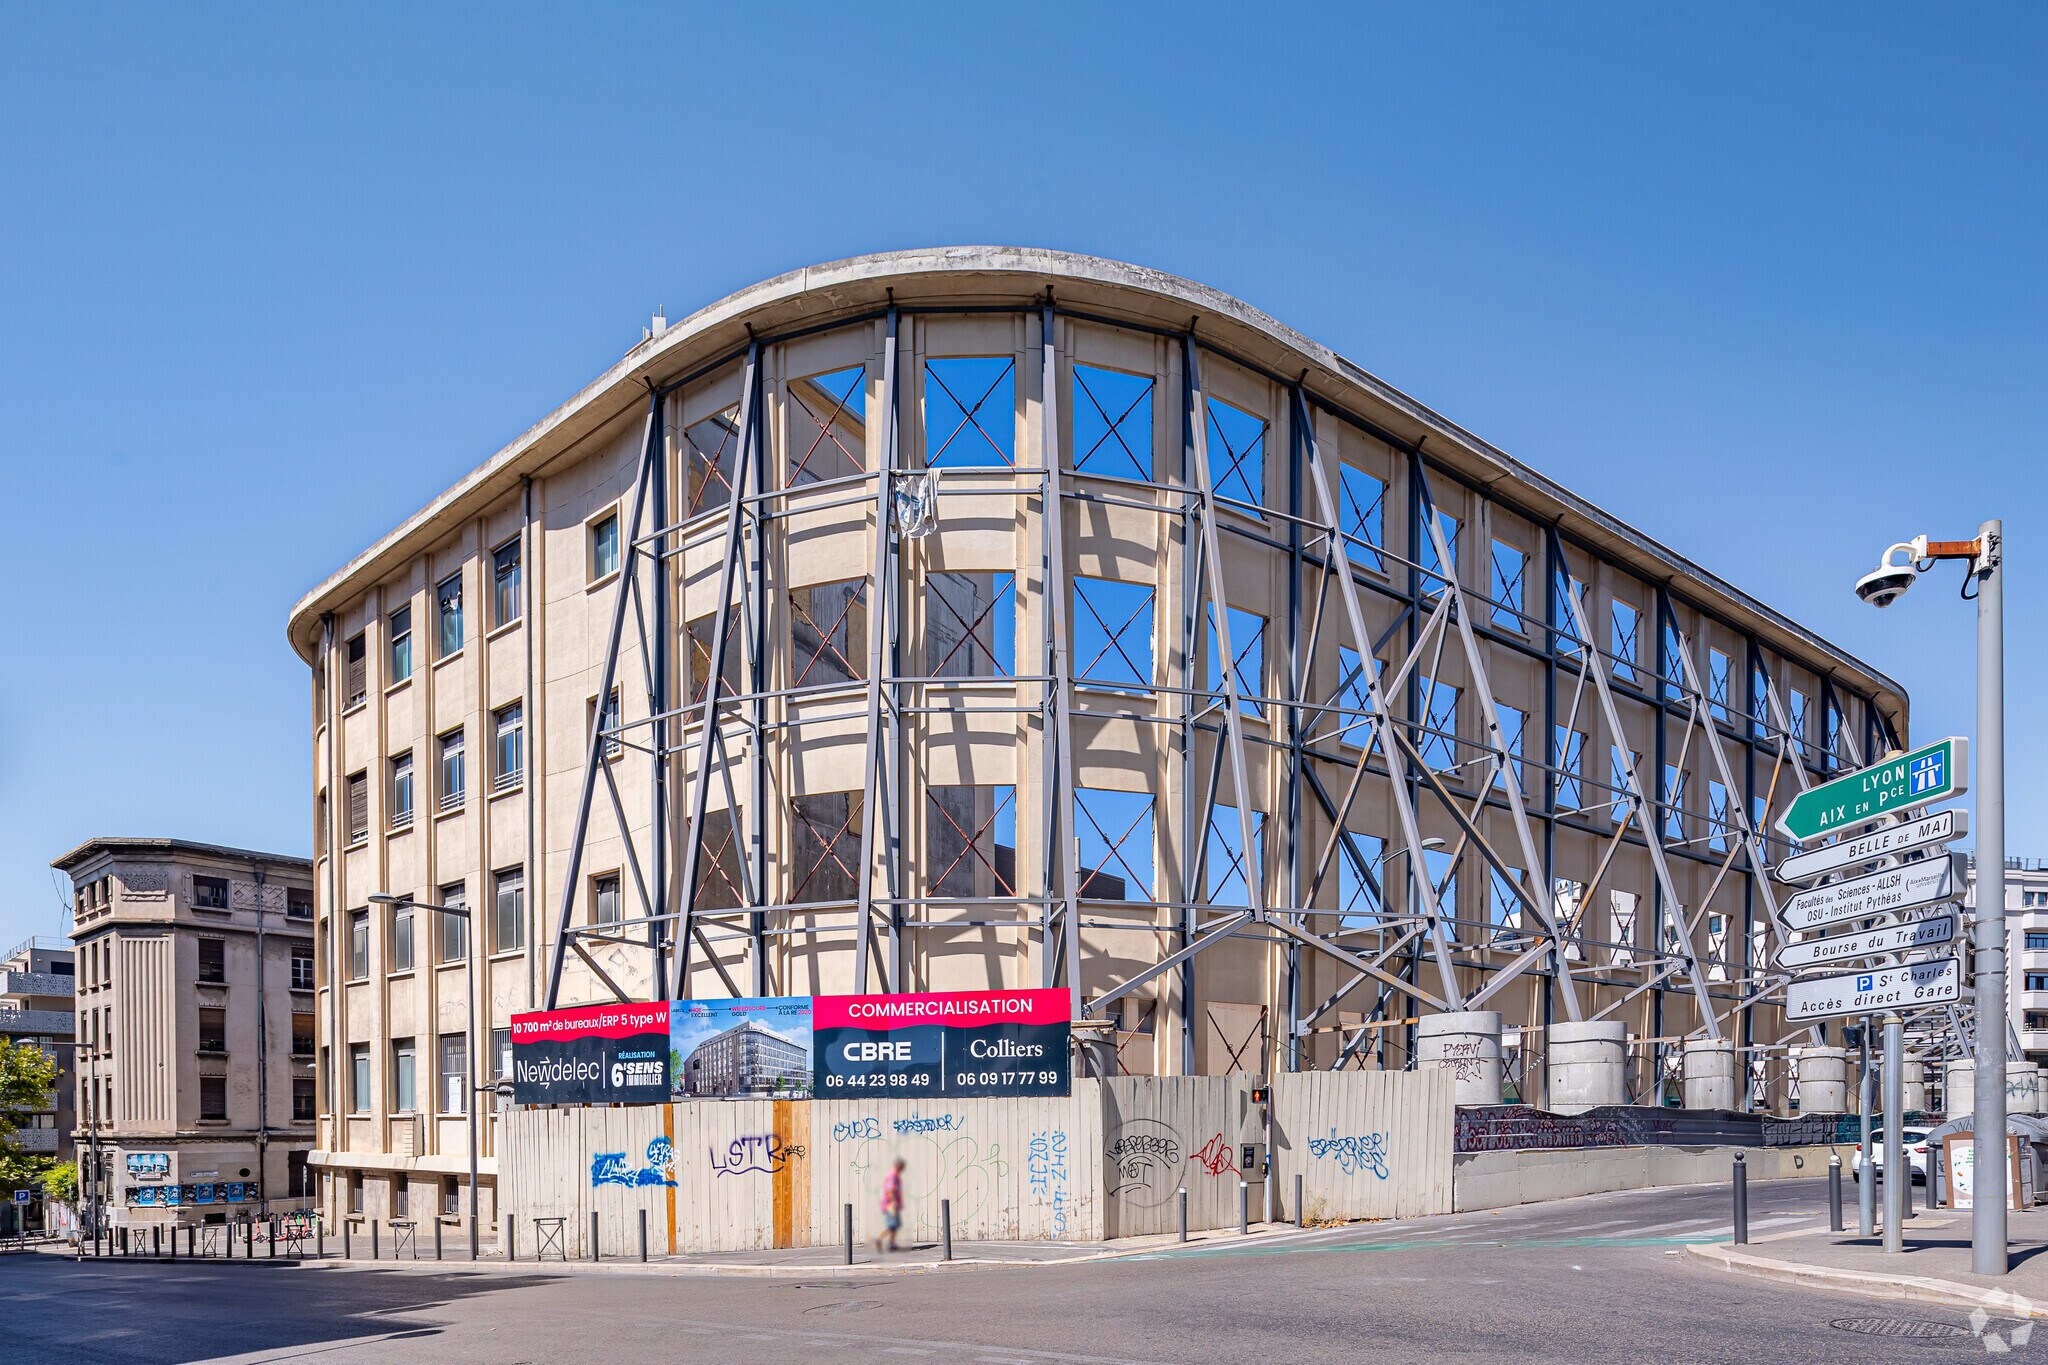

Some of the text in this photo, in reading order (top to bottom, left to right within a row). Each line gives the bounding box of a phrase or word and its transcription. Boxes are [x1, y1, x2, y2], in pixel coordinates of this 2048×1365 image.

[1863, 764, 1904, 793] LYON
[1819, 805, 1846, 827] AIX
[1855, 801, 1869, 815] EN
[1849, 818, 1948, 858] BELLE DE MAI
[1796, 894, 1825, 911] Facultés
[1838, 882, 1870, 901] Sciences
[1876, 874, 1902, 891] ALLSH
[1807, 908, 1823, 922] OSU
[1830, 901, 1863, 918] Institut
[1866, 892, 1902, 910] Pythéas
[1813, 923, 1948, 958] Bourse du Travail
[1859, 966, 1952, 991] P St Charles
[848, 998, 1033, 1018] COMMERCIALISATION
[1800, 984, 1953, 1013] Accès direct Gare
[513, 1023, 522, 1034] 10
[523, 1022, 539, 1033] 700
[552, 1019, 563, 1031] de
[564, 1013, 618, 1030] bureaux/ERP
[621, 1014, 627, 1025] 5
[629, 1012, 654, 1028] type
[655, 1011, 667, 1023] W
[618, 1051, 655, 1060] RÉALISATION
[843, 1039, 1043, 1062] CBRE Colliers
[517, 1056, 600, 1084] Newdelec
[626, 1073, 662, 1086] IMMOBILIER
[825, 1073, 930, 1087] 06 44 23 98 49
[956, 1070, 1058, 1086] 06 09 17 77 99
[19, 1192, 26, 1200] P
